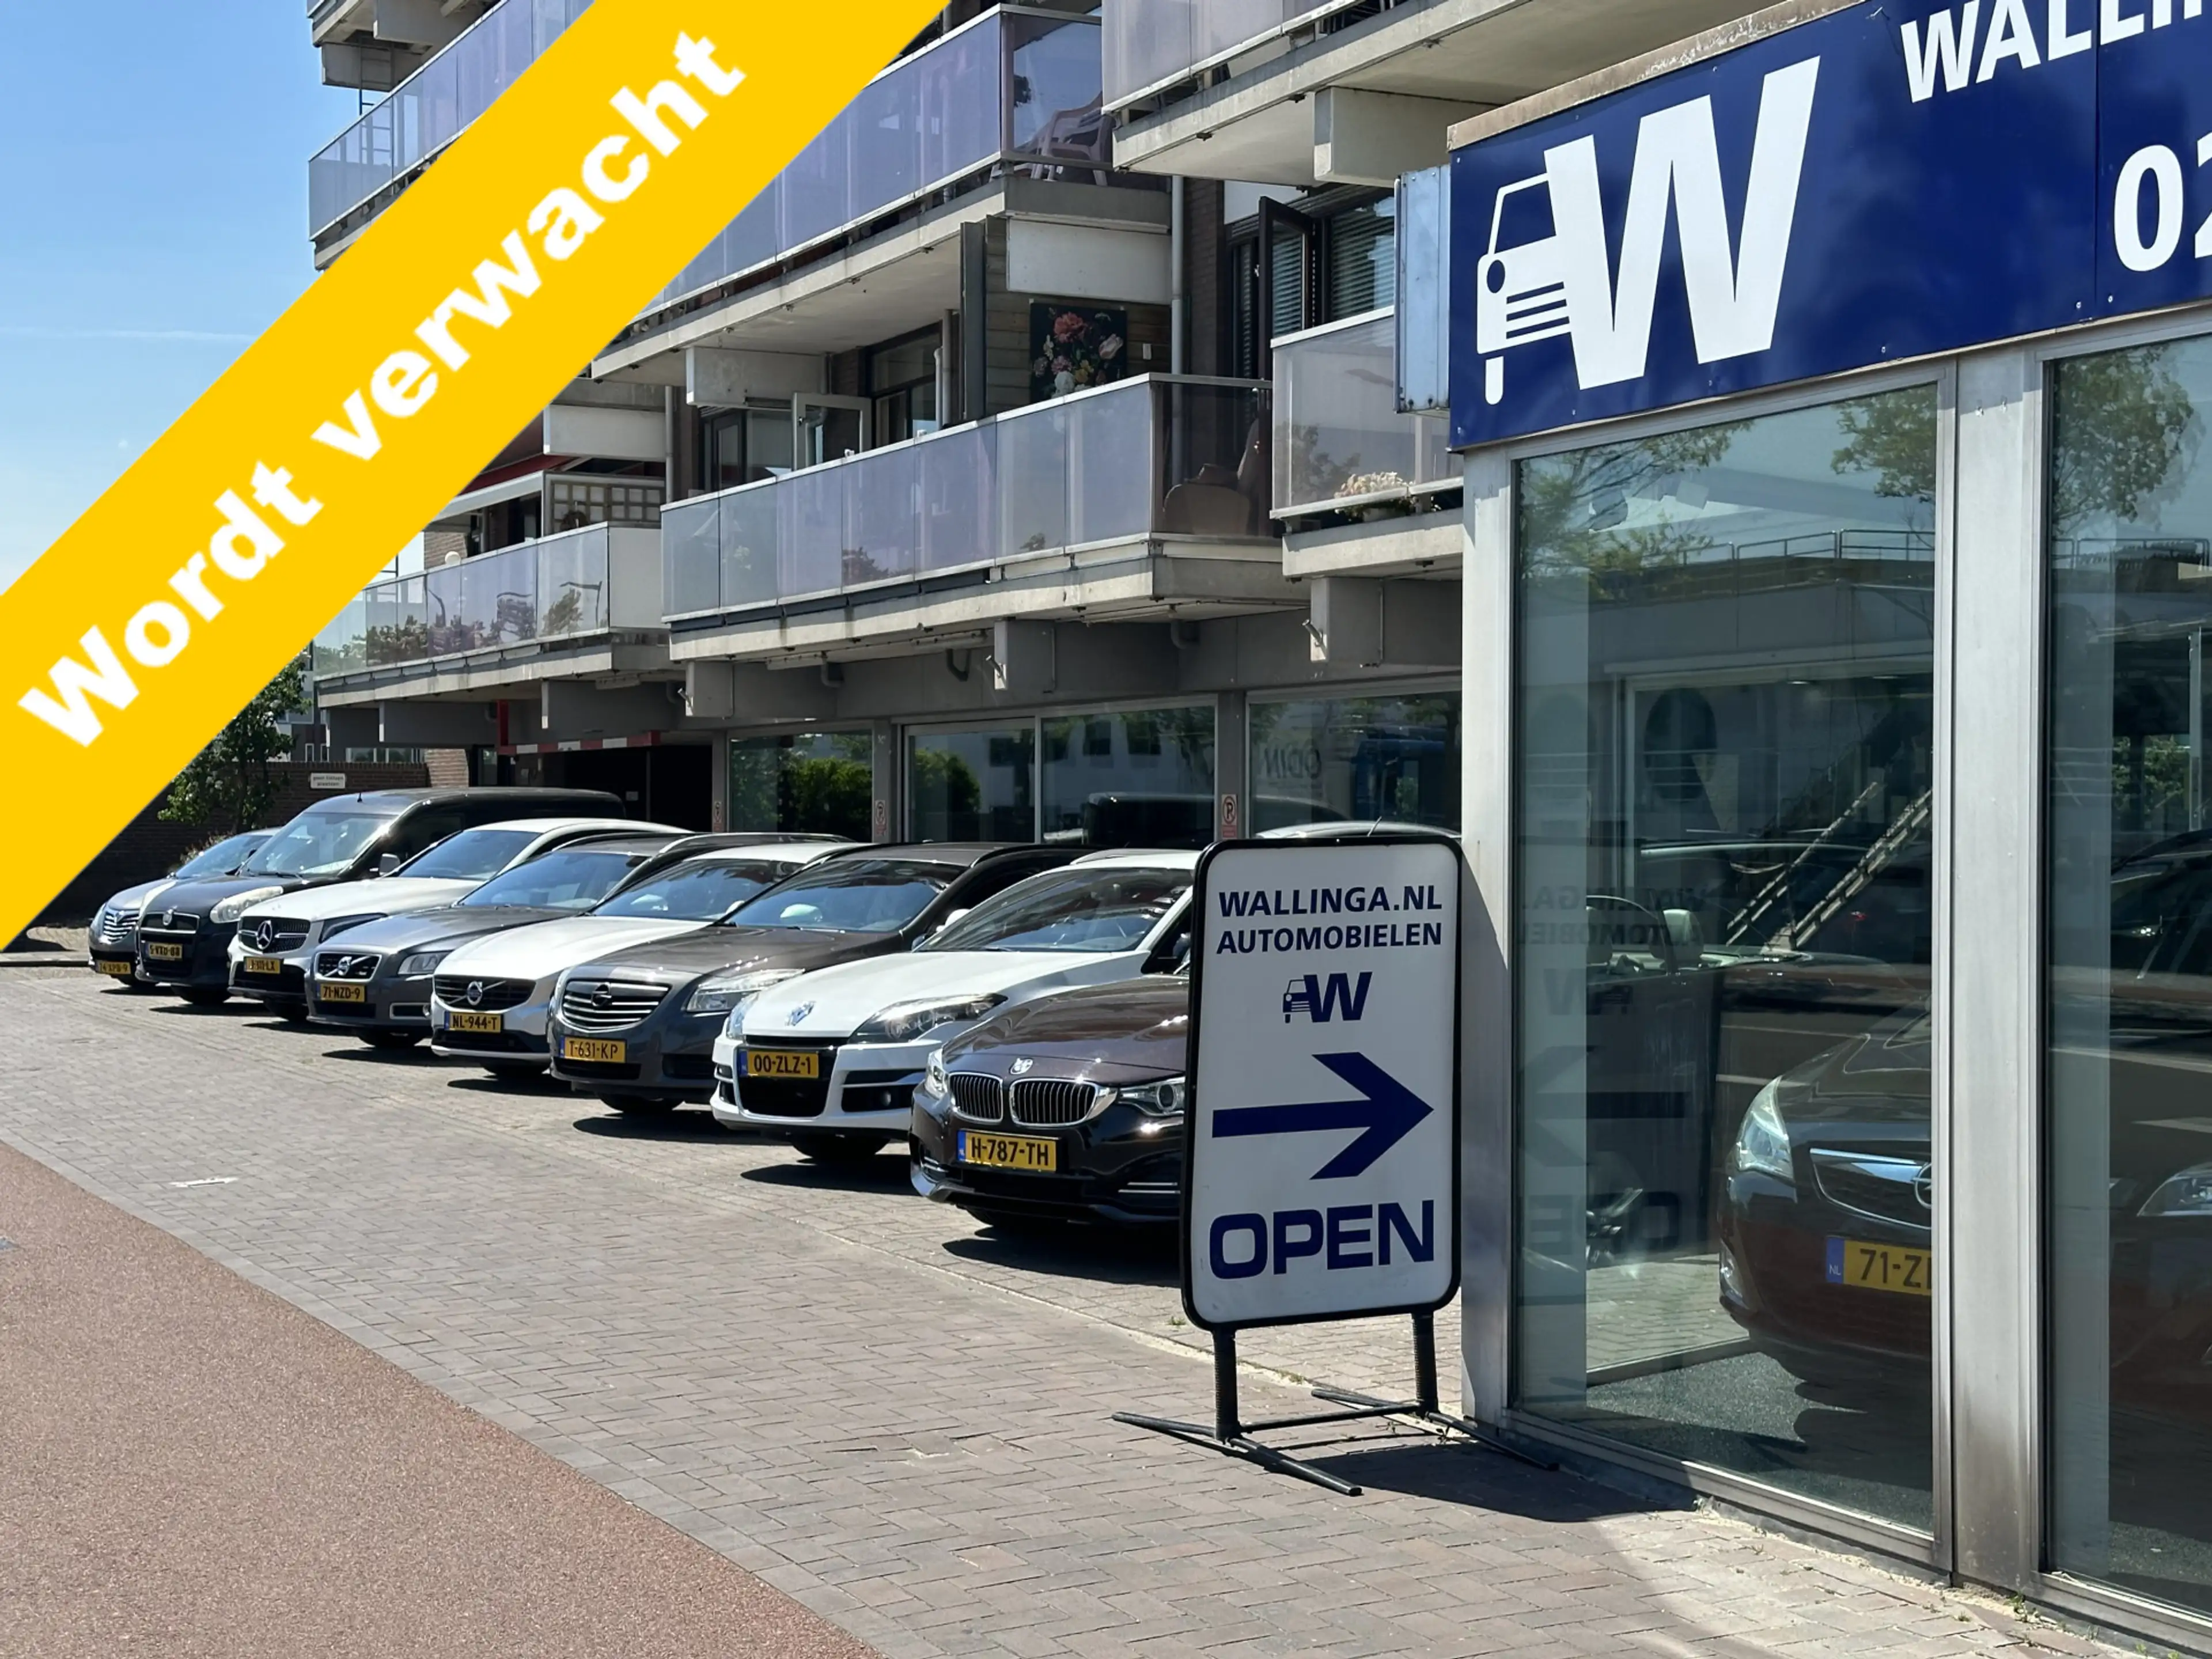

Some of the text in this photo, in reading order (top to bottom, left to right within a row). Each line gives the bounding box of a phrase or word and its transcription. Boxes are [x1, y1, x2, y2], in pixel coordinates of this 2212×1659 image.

[1544, 56, 1820, 390] W
[1219, 885, 1442, 917] WALLINGA.NL
[1216, 922, 1442, 955] AUTOMOBIELEN
[1303, 972, 1373, 1023] W
[452, 1015, 497, 1031] NL-944-T
[569, 1040, 619, 1059] T-631-KP
[753, 1054, 811, 1075] 00-ZLZ-1
[971, 1137, 1048, 1166] H-787-TH
[1210, 1199, 1434, 1280] OPEN
